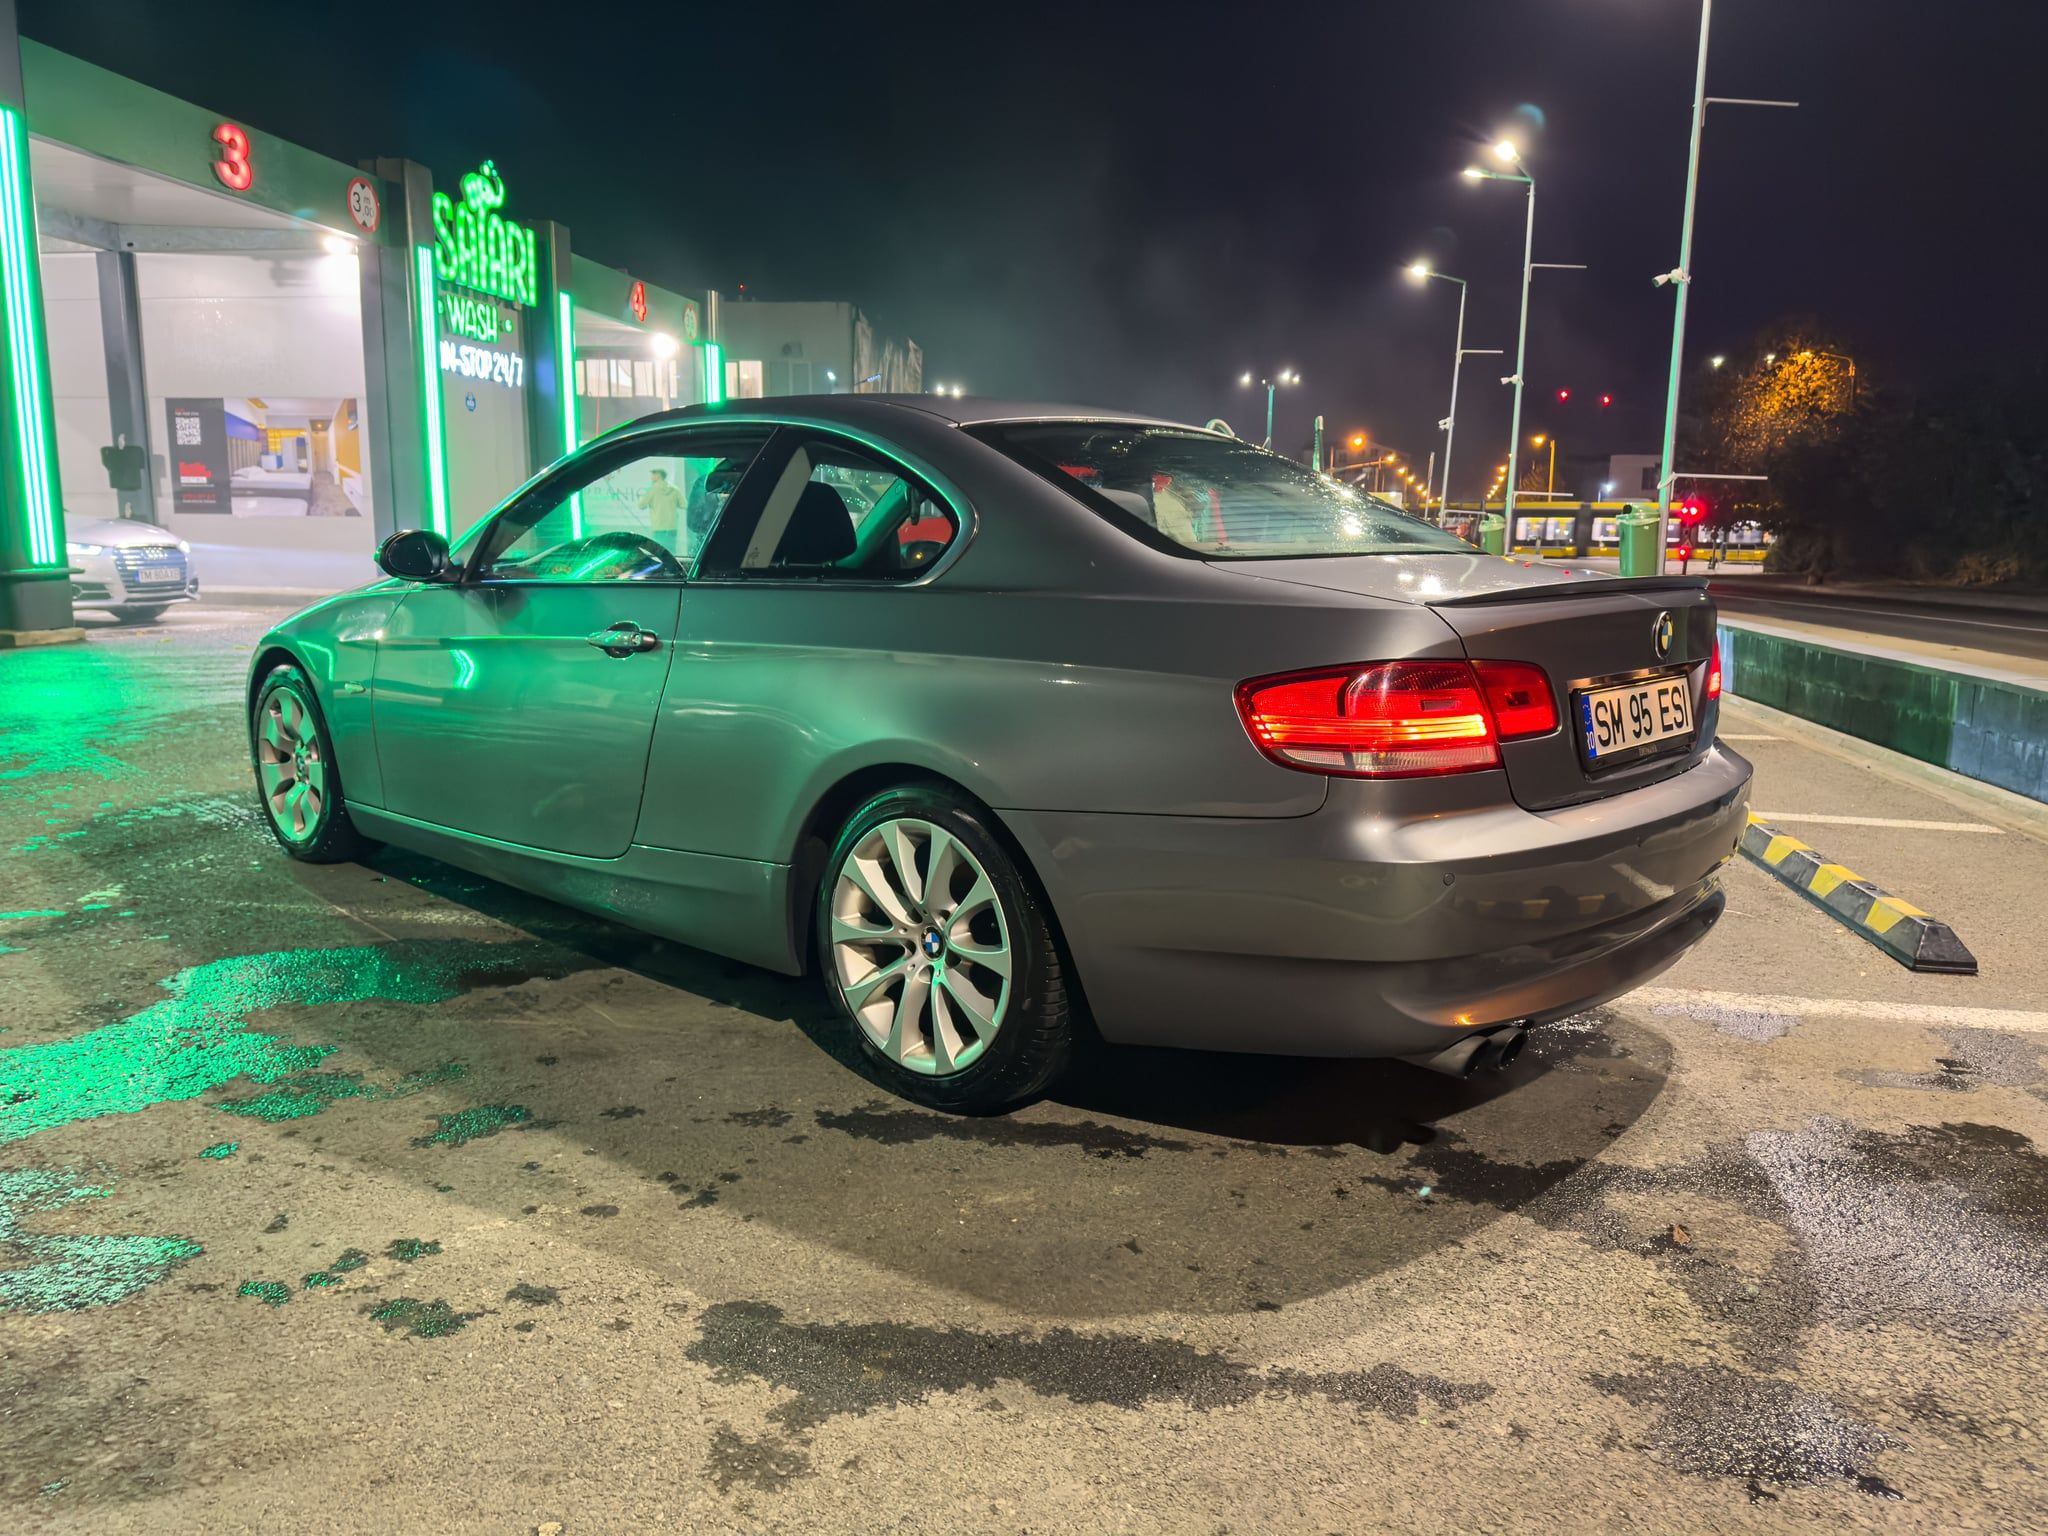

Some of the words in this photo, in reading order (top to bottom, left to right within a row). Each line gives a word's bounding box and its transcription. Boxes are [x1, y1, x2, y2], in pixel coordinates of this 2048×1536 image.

[214, 123, 252, 191] 3
[353, 191, 361, 212] 3
[432, 192, 537, 307] SAFARI
[447, 294, 498, 343] WASH
[630, 281, 646, 322] 4
[493, 351, 523, 388] 24/7
[1595, 698, 1625, 747] SM
[1629, 692, 1652, 739] 95
[1657, 684, 1689, 732] ESI
